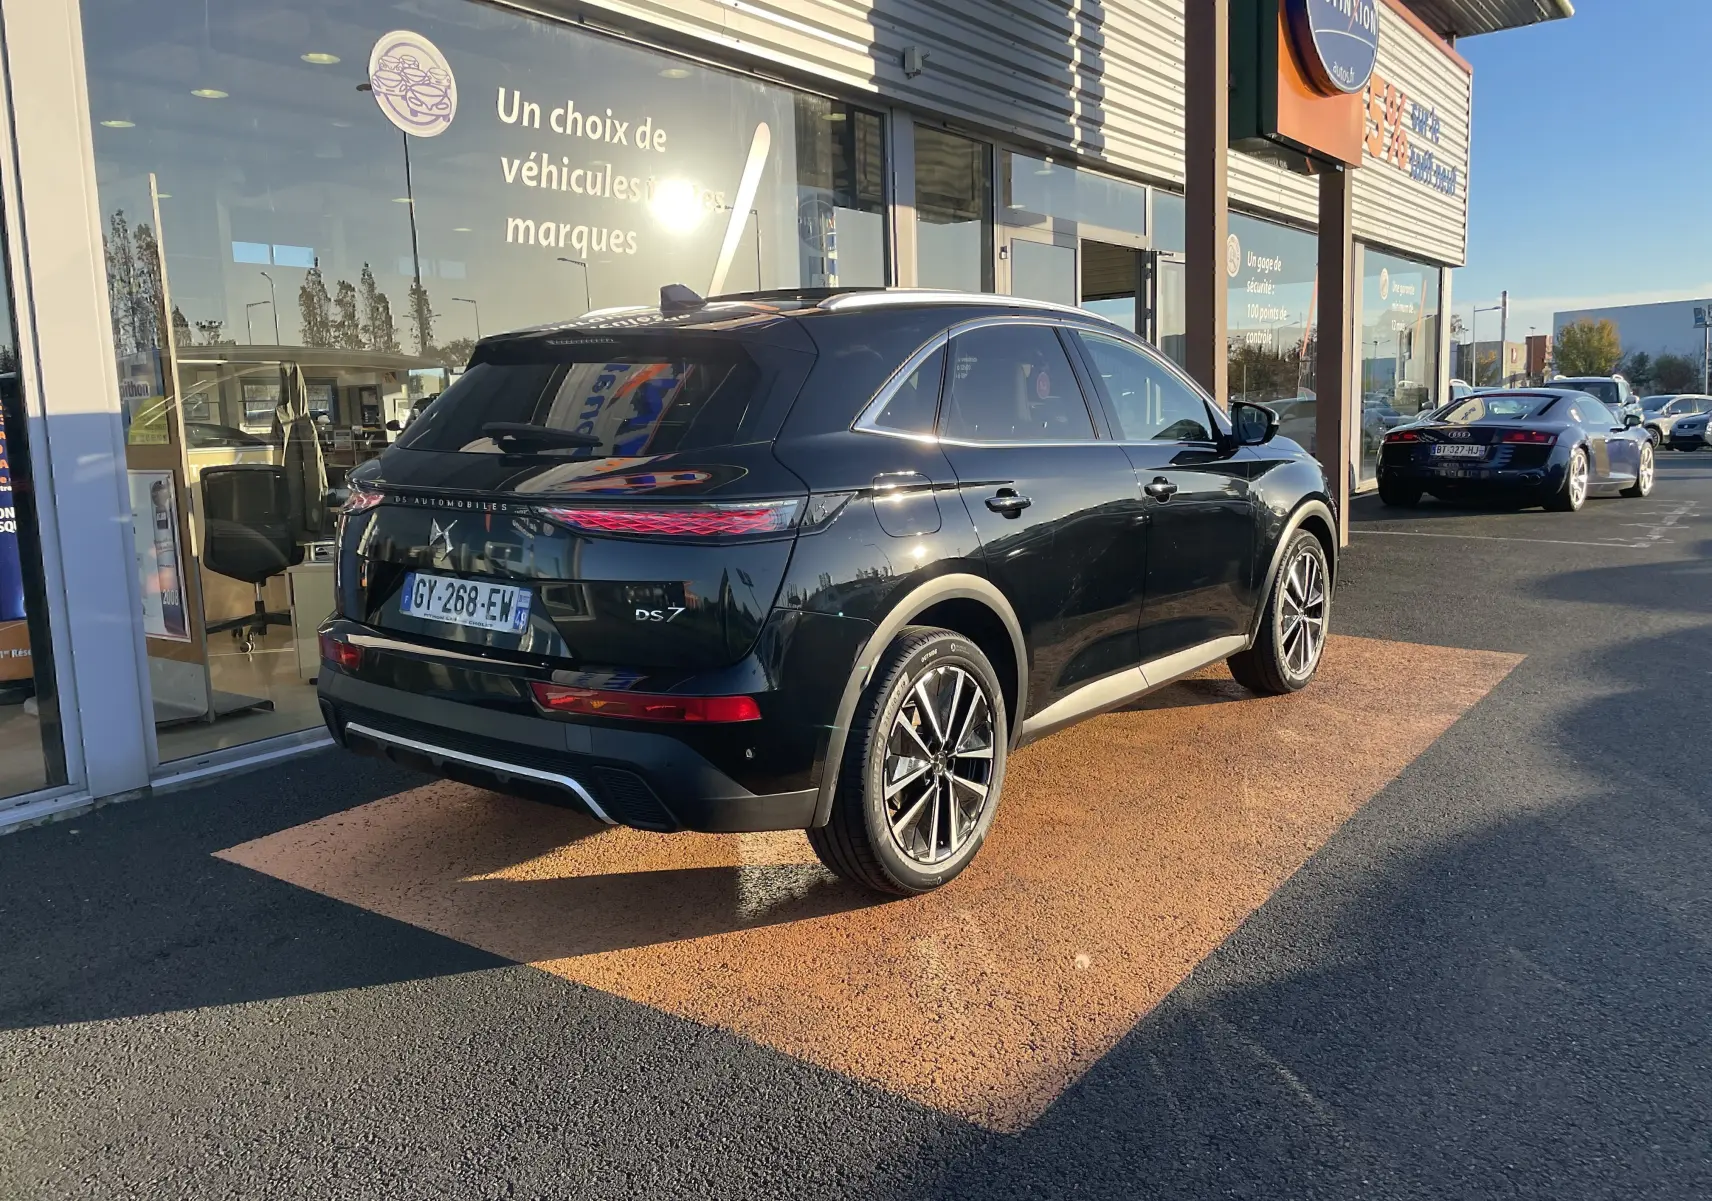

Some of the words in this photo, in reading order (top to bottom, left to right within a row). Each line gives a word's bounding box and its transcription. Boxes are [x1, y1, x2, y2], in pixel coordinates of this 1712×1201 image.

[496, 87, 541, 129] Un
[549, 100, 629, 146] choix
[634, 117, 667, 153] de
[501, 152, 640, 202] véhicules
[506, 217, 638, 259] marques
[1247, 251, 1257, 268] Un
[1257, 255, 1274, 274] gage
[1274, 255, 1282, 272] de
[1247, 304, 1259, 319] 100
[1259, 304, 1279, 321] points
[1279, 305, 1287, 320] de
[1246, 330, 1272, 344] contrôle
[1436, 444, 1479, 456] BT-327-HJ
[414, 498, 508, 511] AUTOMOBILES
[413, 578, 514, 623] GY-268-EW
